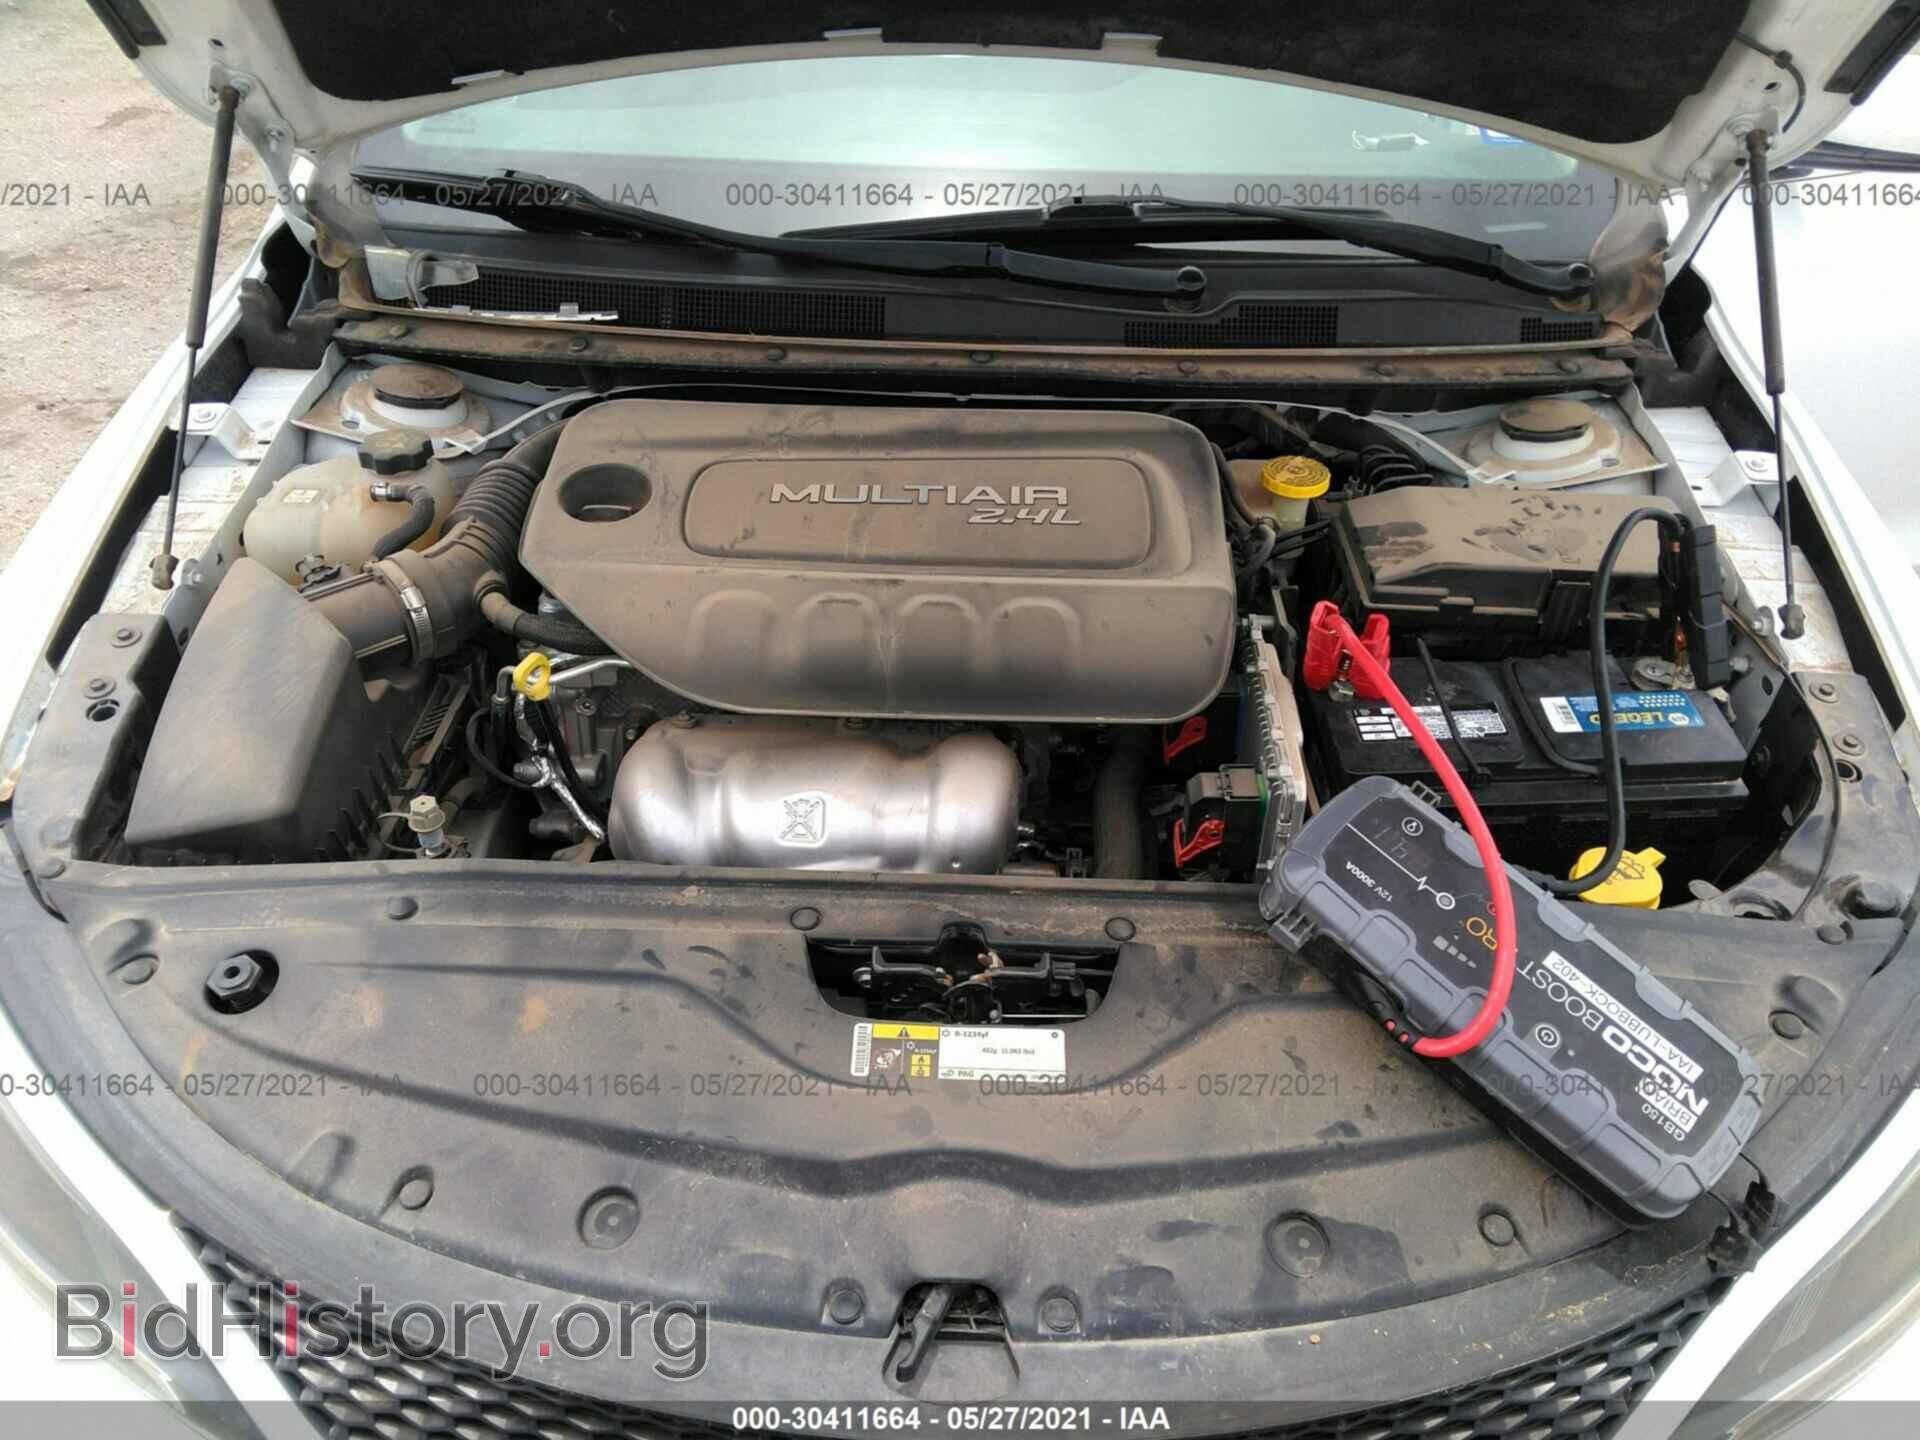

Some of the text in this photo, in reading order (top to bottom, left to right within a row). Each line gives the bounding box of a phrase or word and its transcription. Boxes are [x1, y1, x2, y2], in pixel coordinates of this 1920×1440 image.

[769, 483, 1069, 506] MULTIAIR
[967, 507, 1082, 526] 2.4L
[1588, 711, 1665, 725] LEGED
[1344, 860, 1393, 903] 12V 3000A
[1465, 915, 1710, 1117] NOCO BOOST RO
[1551, 957, 1695, 1075] IAA-LUBBOCK-402
[1641, 1103, 1685, 1142] GB150
